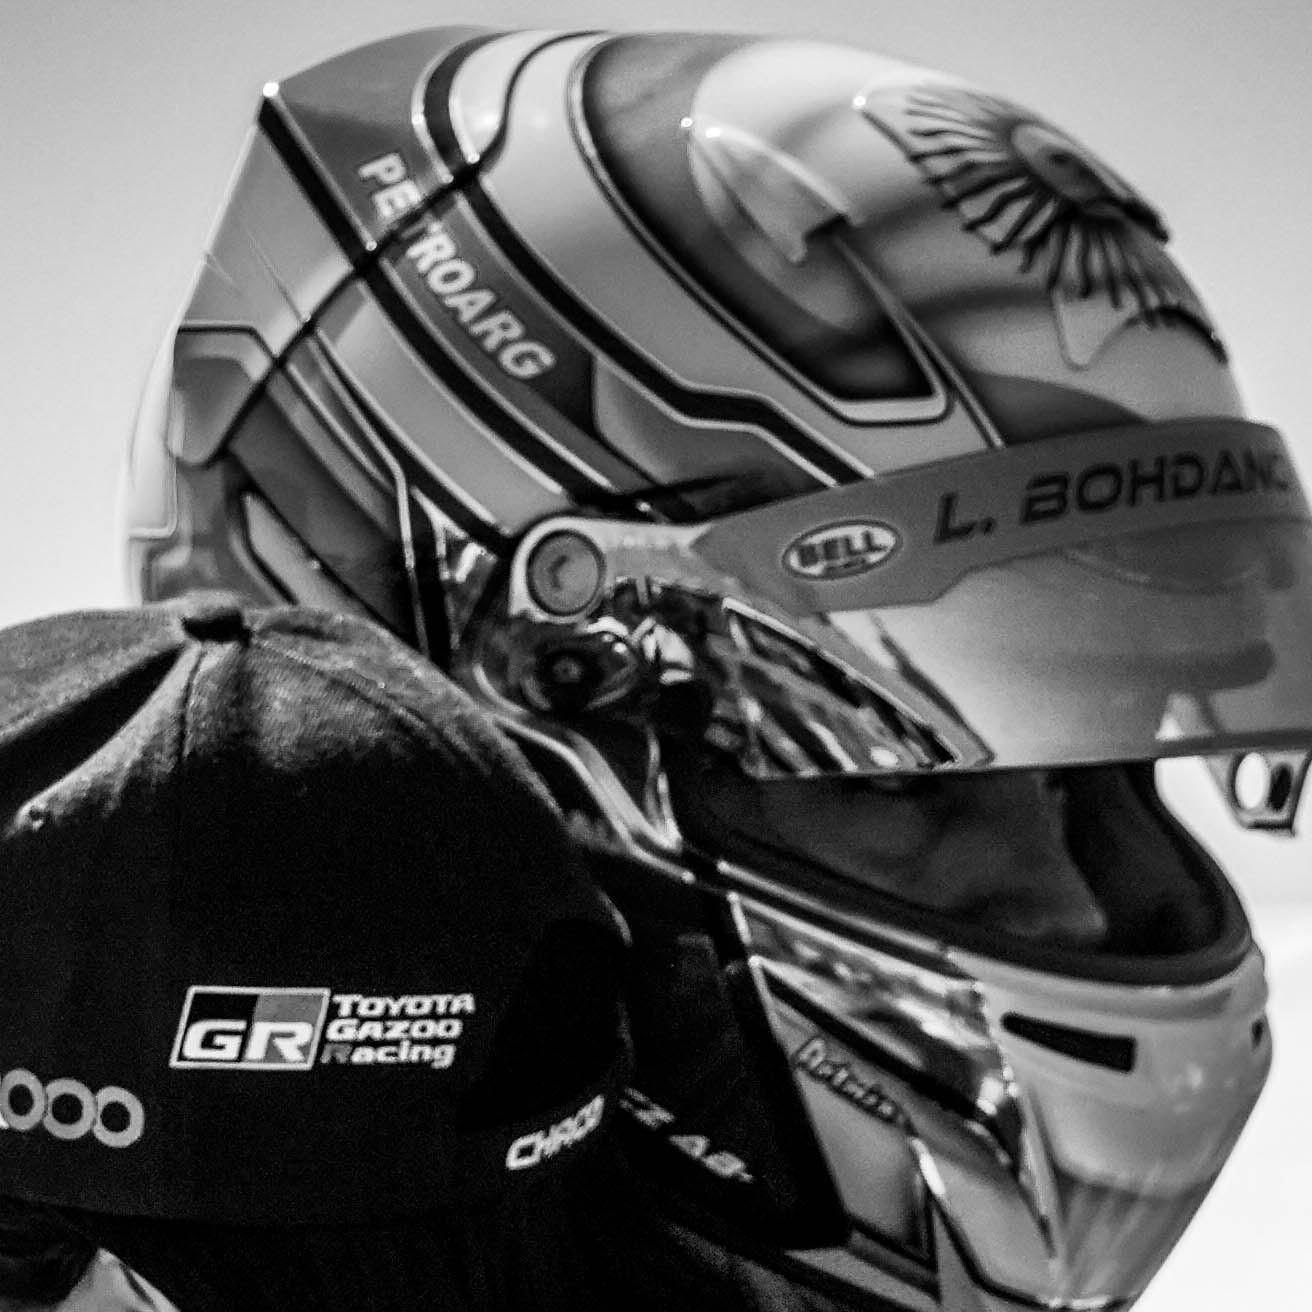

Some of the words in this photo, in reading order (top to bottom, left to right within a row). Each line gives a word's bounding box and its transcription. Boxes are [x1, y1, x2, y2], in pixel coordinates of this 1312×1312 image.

[797, 529, 891, 569] BELL
[332, 993, 476, 1018] TOYOTA
[181, 1018, 315, 1063] GR
[325, 1017, 464, 1042] GAZOO
[320, 1039, 456, 1070] Racing
